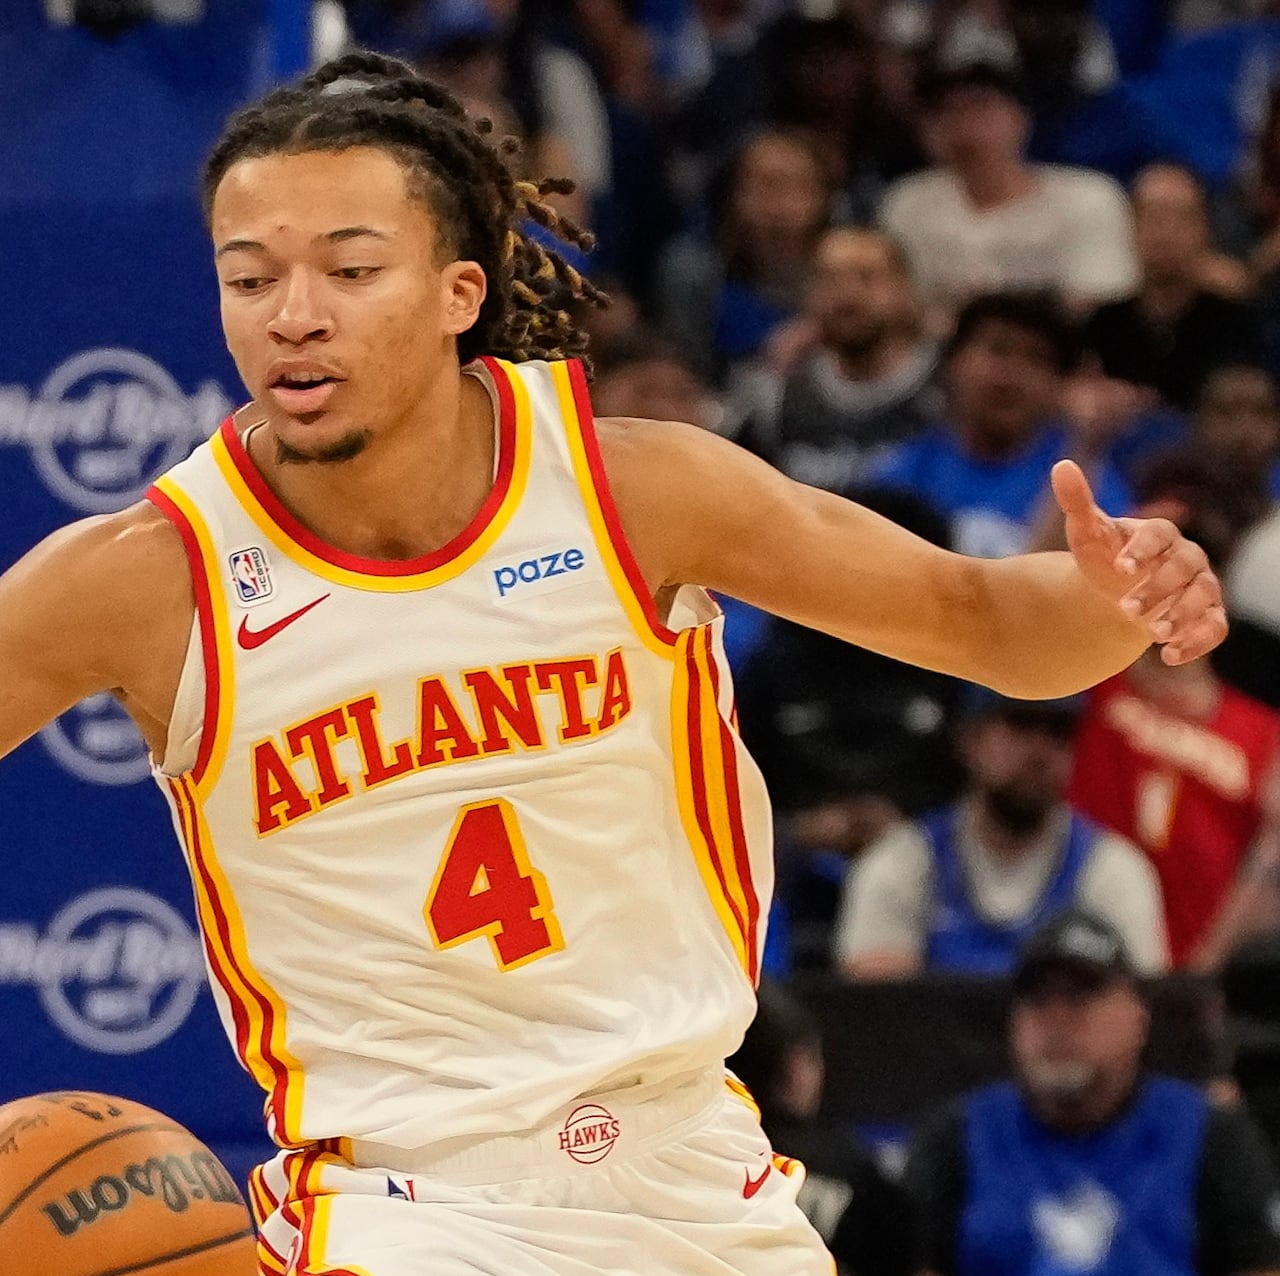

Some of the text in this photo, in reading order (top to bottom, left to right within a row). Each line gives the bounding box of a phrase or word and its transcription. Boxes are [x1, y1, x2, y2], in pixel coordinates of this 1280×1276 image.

[251, 551, 268, 592] DEBUT
[493, 548, 585, 597] paze
[251, 645, 633, 838] ATLANTA
[423, 797, 566, 973] 4
[558, 1120, 620, 1150] HAWKS
